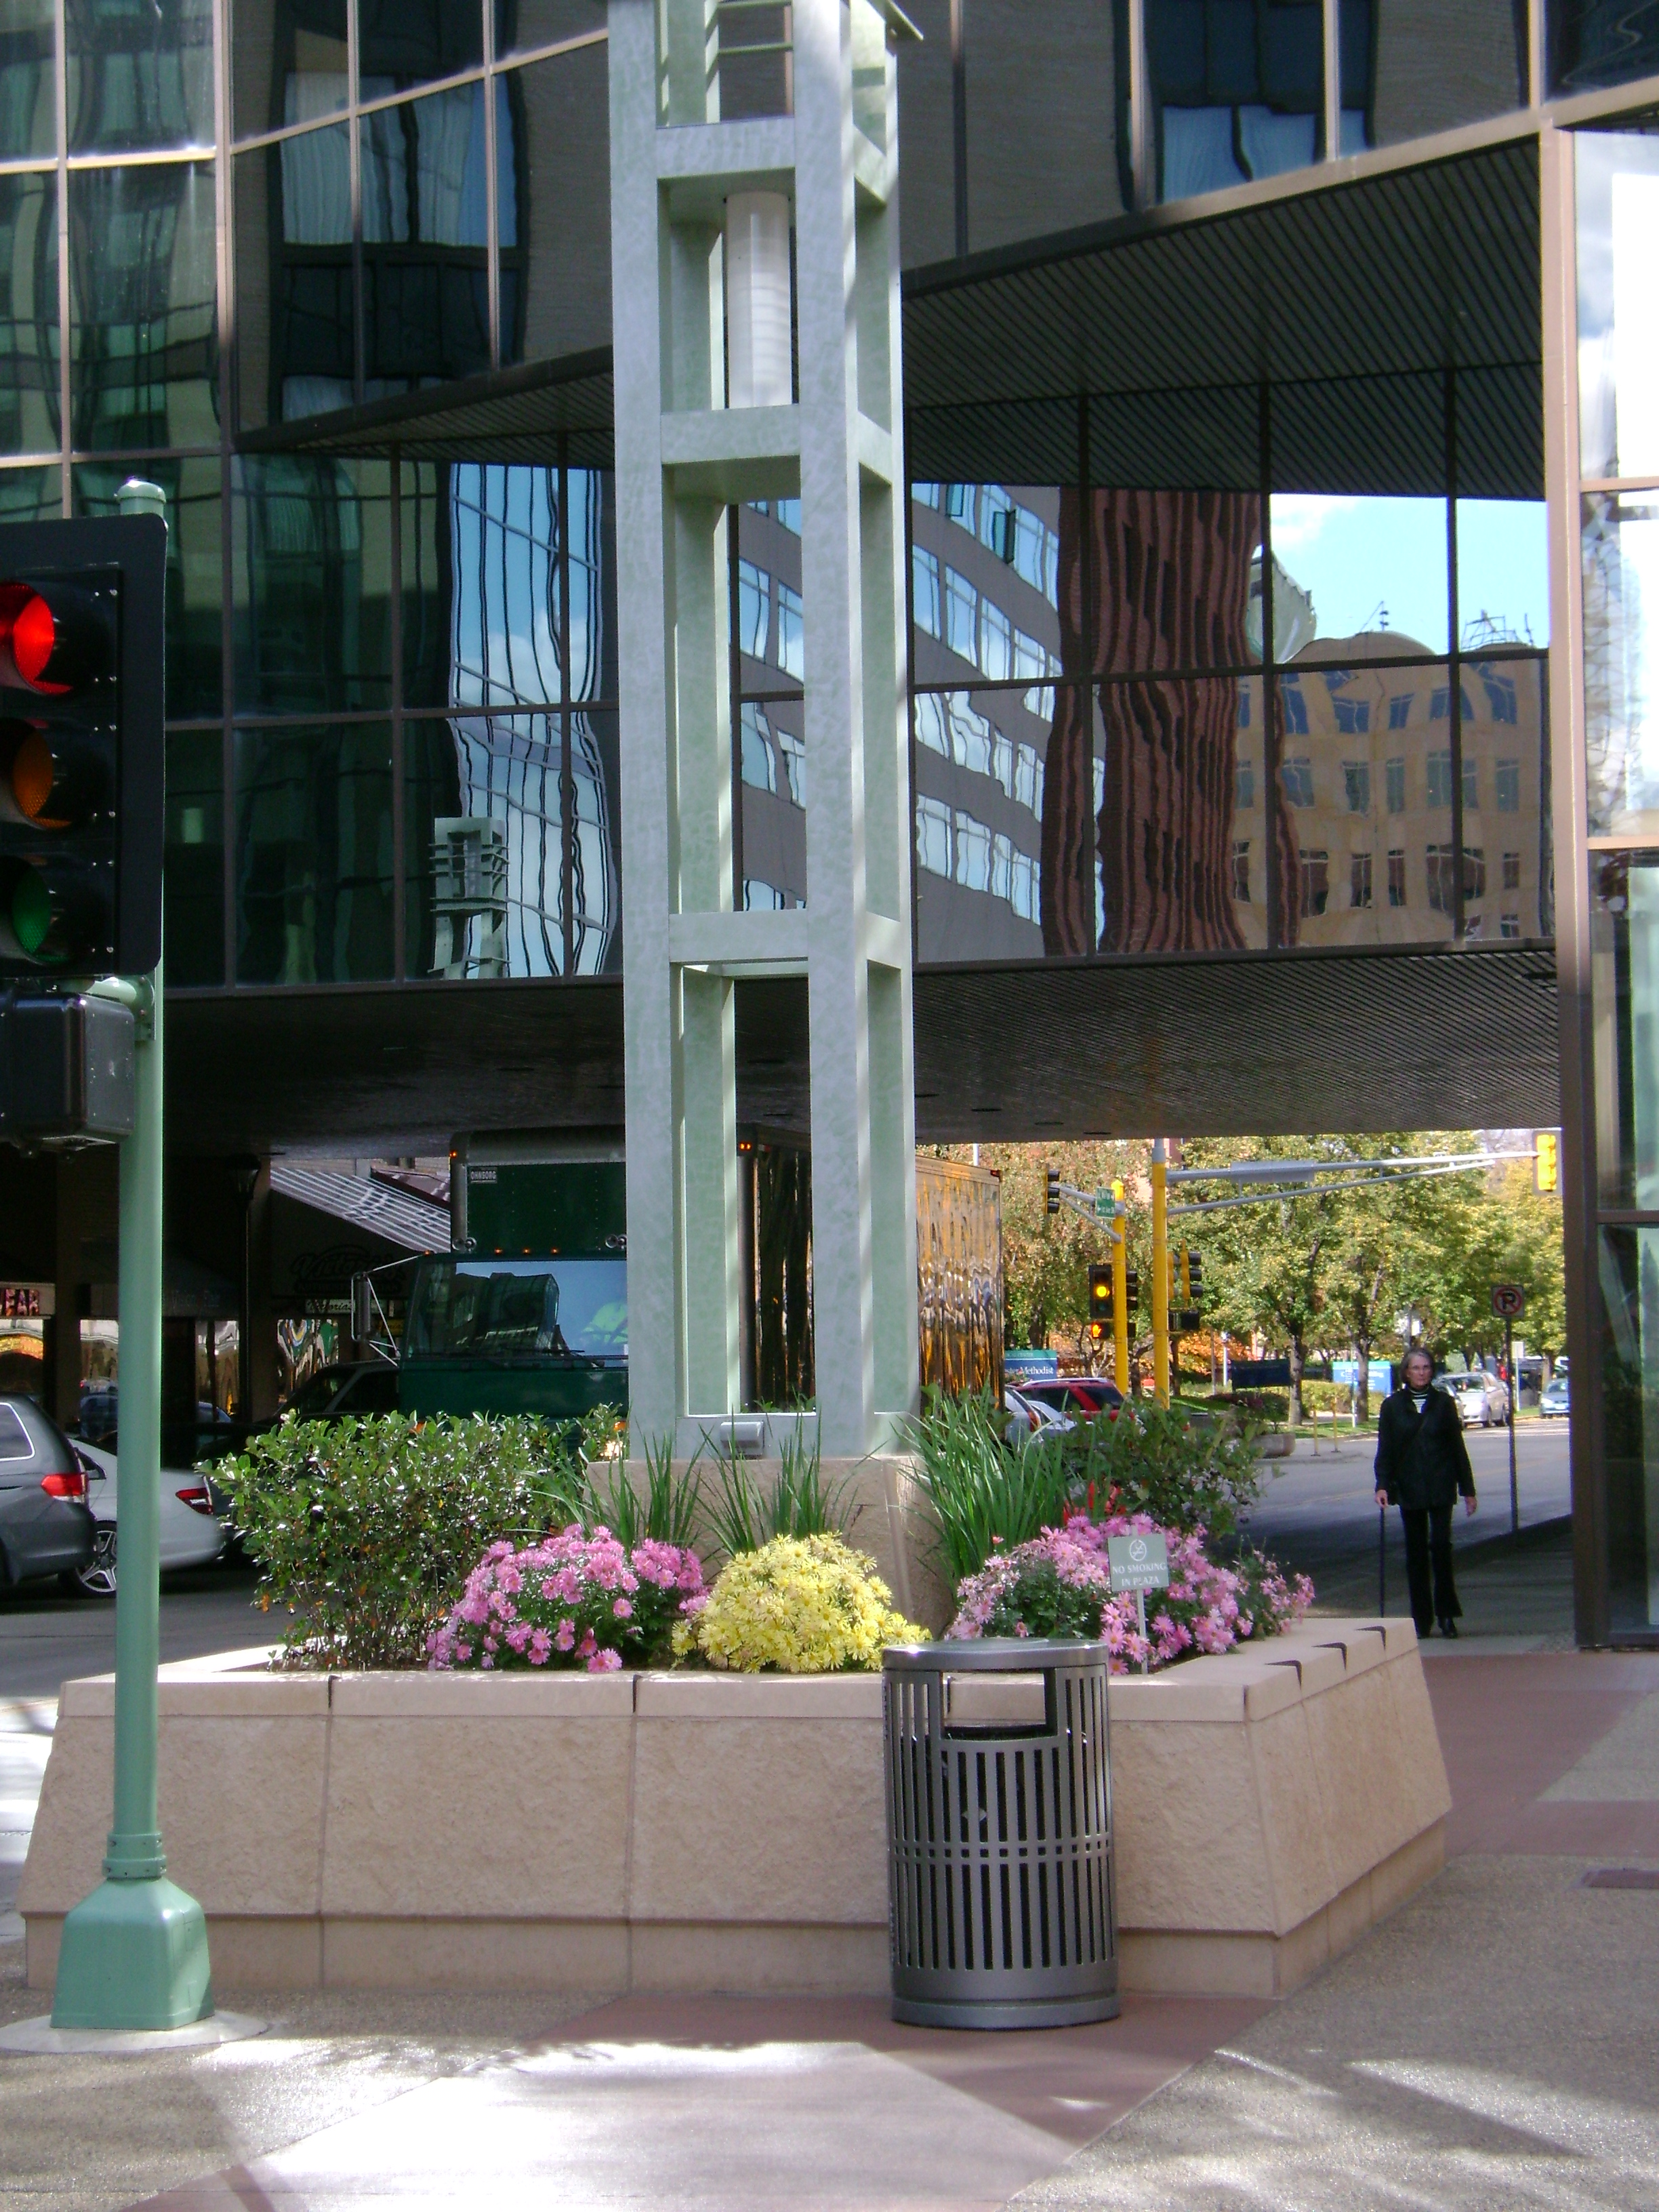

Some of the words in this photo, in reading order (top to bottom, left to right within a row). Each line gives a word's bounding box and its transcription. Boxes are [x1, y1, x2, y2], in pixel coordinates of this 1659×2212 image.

[0, 1289, 40, 1315] EAR
[1023, 1366, 1053, 1374] Methodist
[1113, 1565, 1125, 1574] NO
[1128, 1562, 1166, 1573] SMOKING
[1122, 1578, 1131, 1586] IN
[1132, 1576, 1160, 1586] PLAZA
